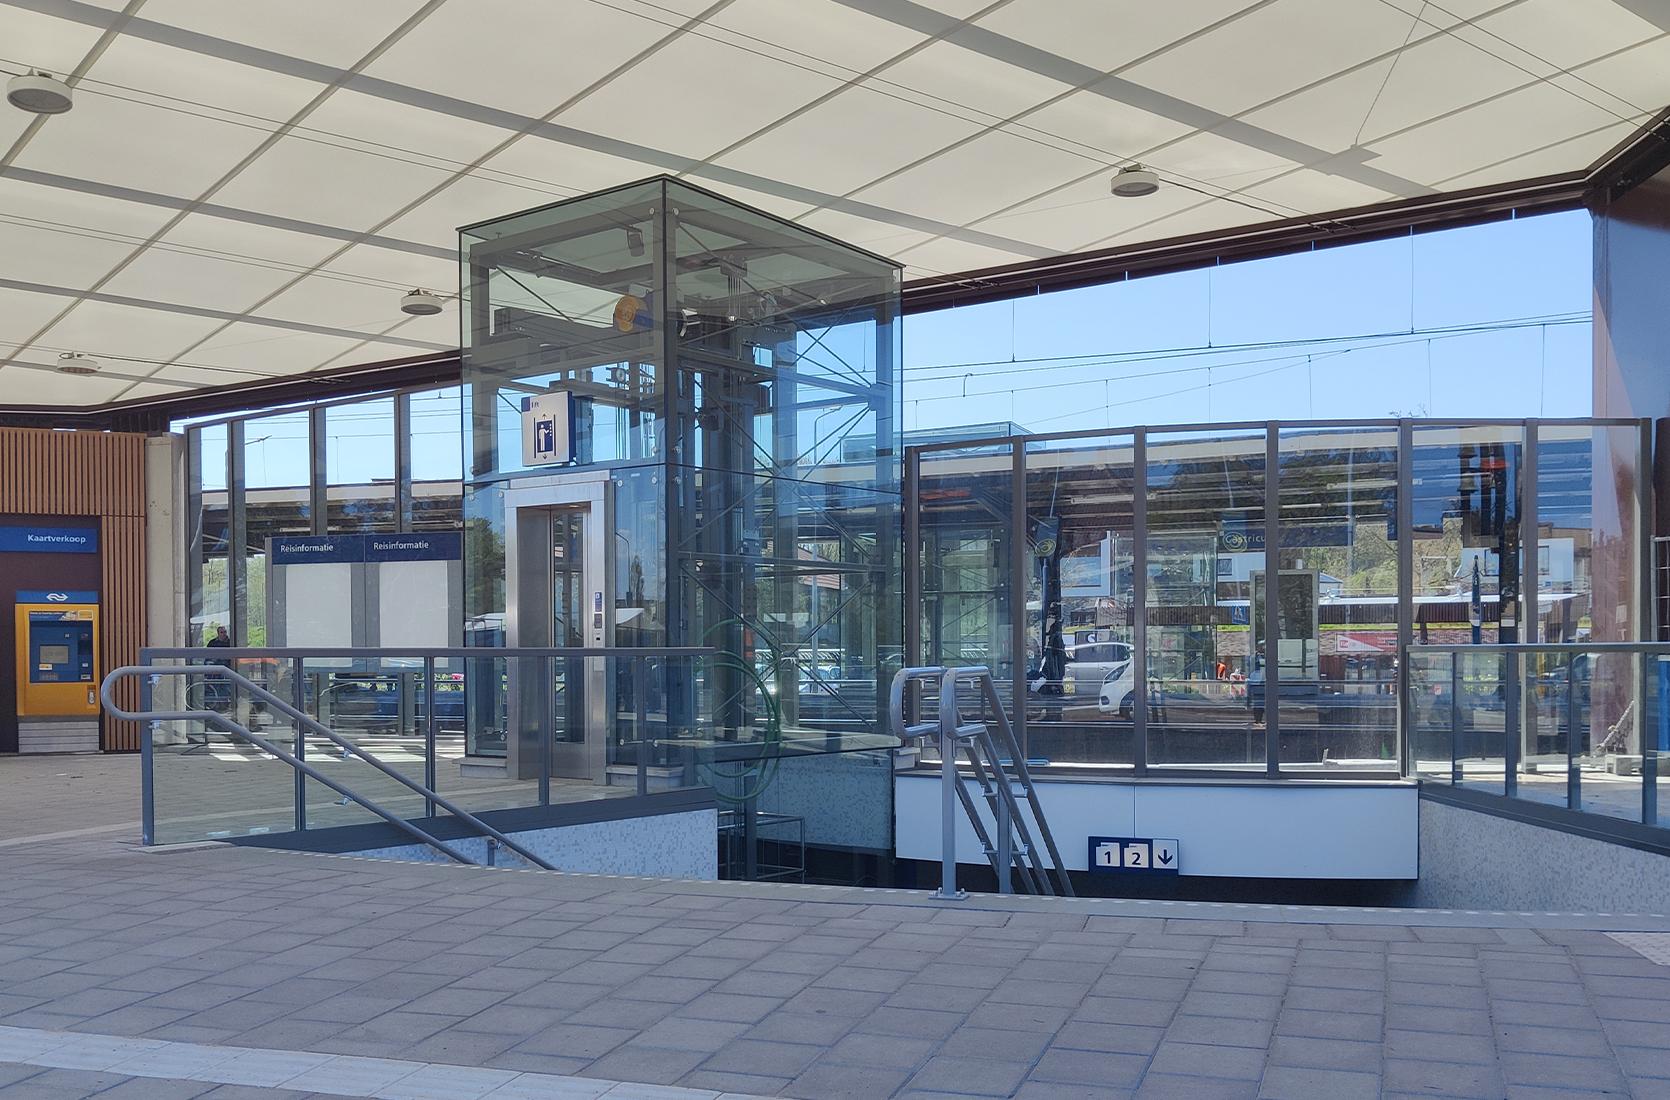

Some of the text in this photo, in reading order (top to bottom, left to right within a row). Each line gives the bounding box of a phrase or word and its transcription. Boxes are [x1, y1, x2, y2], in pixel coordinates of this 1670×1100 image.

[27, 534, 86, 544] Kaartverkoop
[280, 543, 334, 553] Reisinformatie
[373, 540, 429, 550] Reisinformatie
[1104, 850, 1141, 865] 1 2
